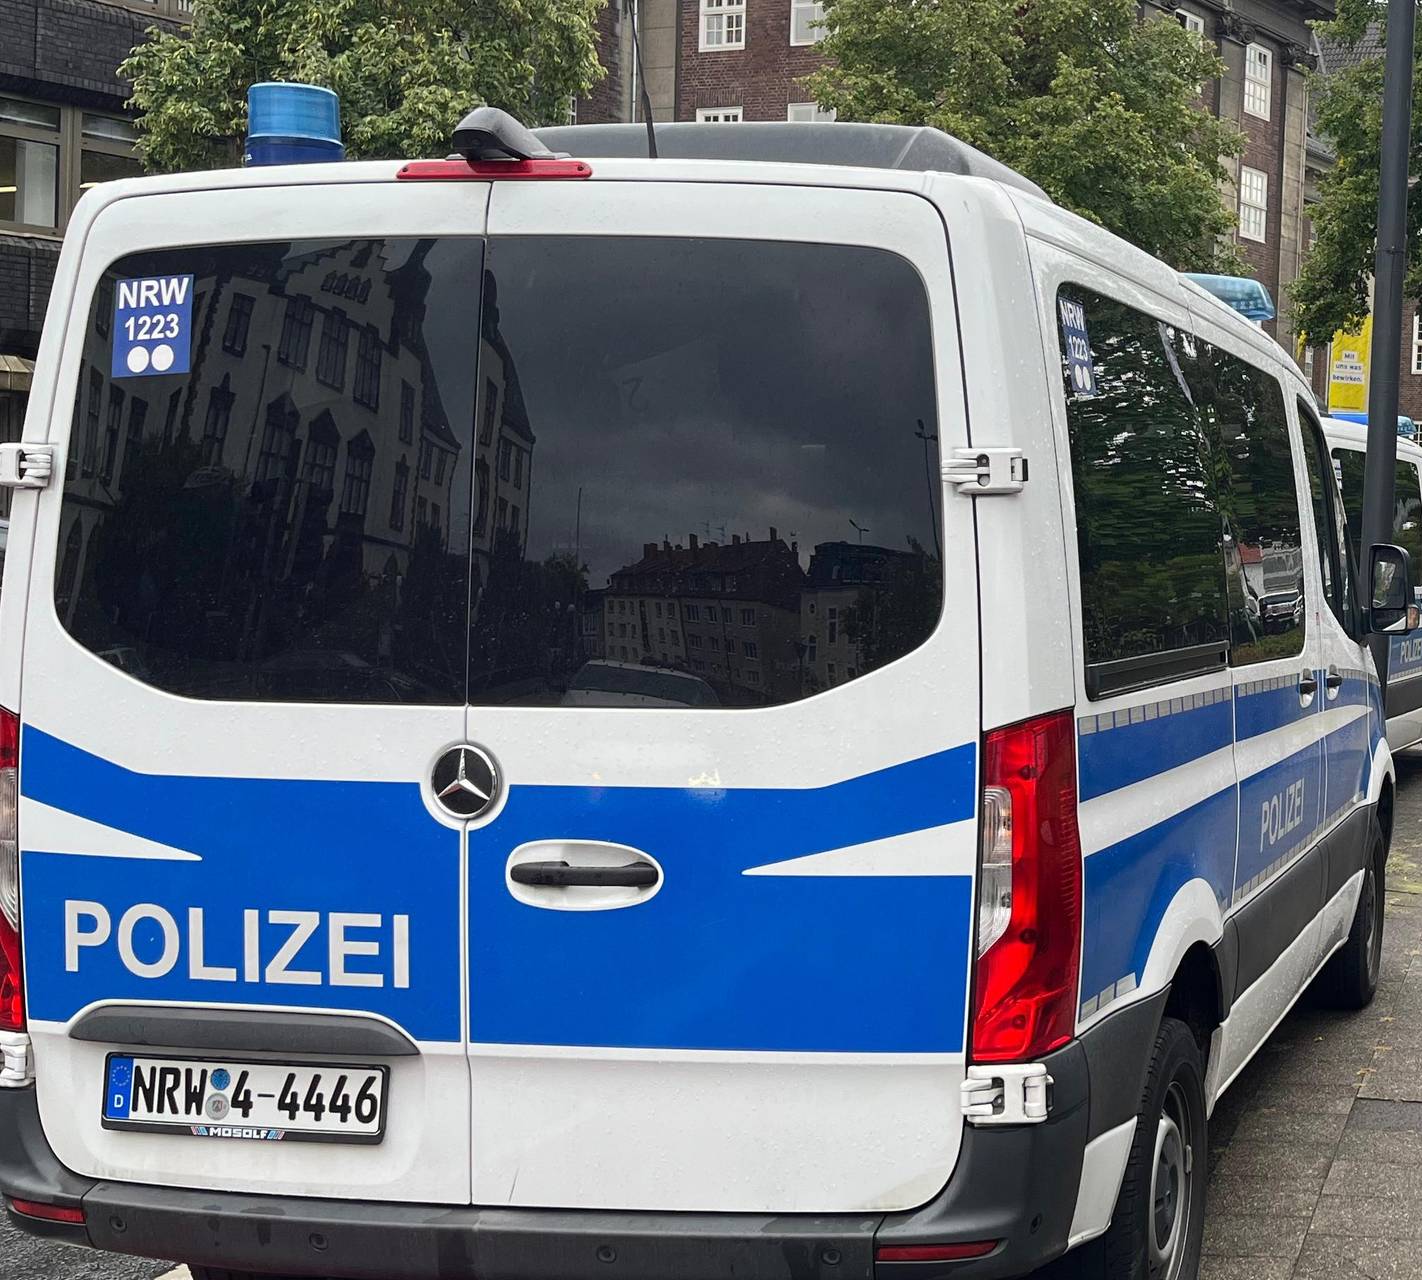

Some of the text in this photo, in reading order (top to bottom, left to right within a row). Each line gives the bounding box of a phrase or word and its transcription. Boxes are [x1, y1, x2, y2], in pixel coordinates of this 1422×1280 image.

[119, 277, 190, 310] NRW
[124, 313, 180, 341] 1223
[1059, 299, 1085, 332] NRW
[1068, 334, 1088, 362] 1223
[1260, 777, 1305, 853] POLIZEI
[64, 899, 410, 989] POLIZEI
[113, 1094, 124, 1108] D
[131, 1065, 379, 1124] NRW 4-4446
[209, 1127, 269, 1140] MOSOLF
